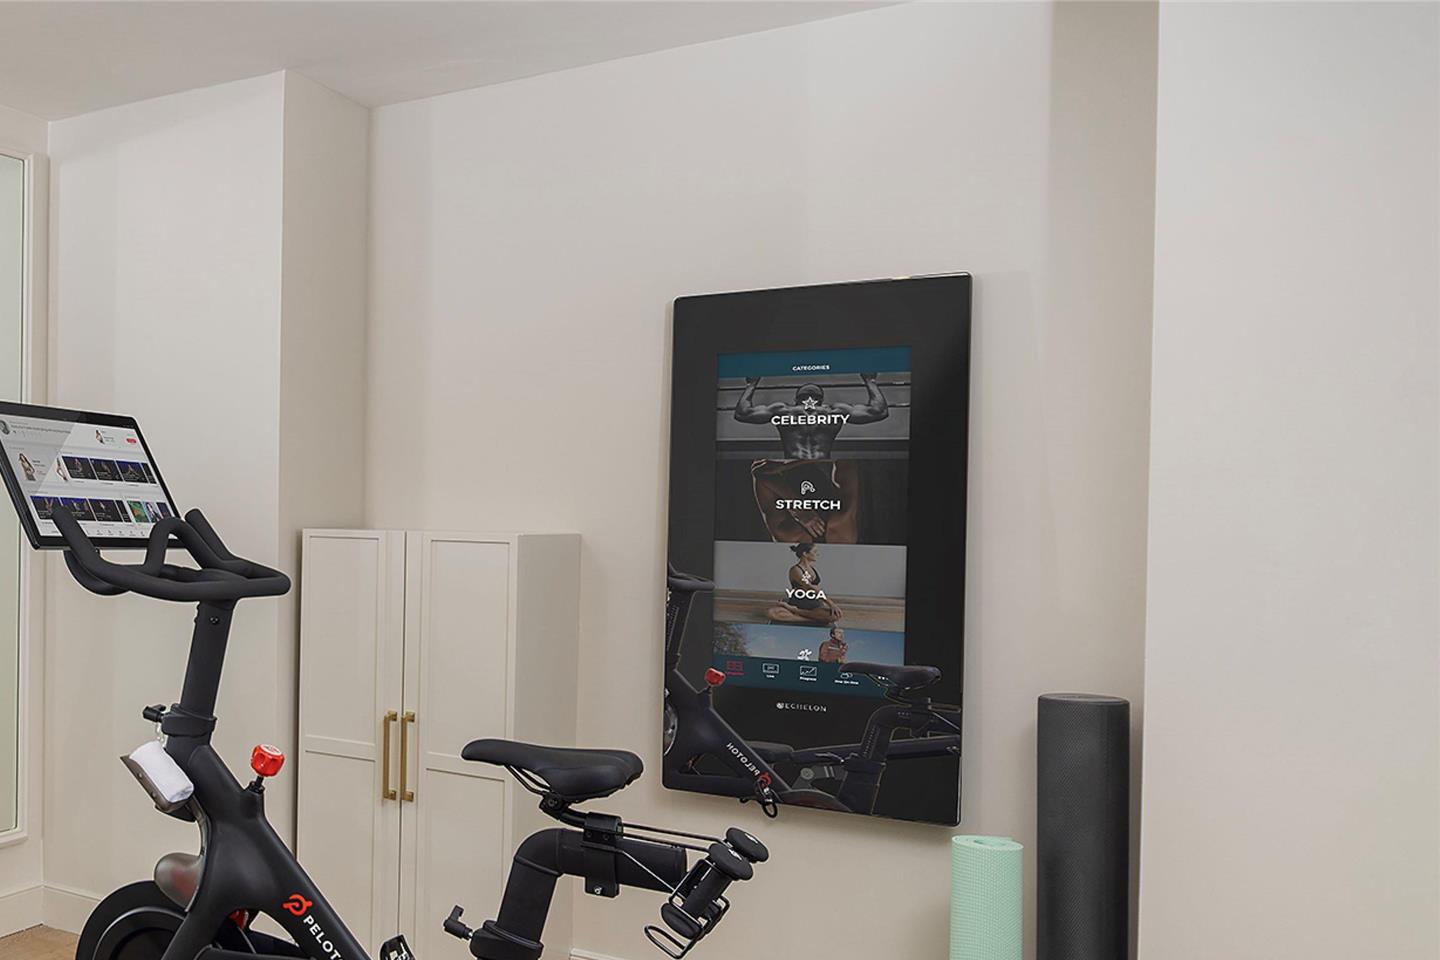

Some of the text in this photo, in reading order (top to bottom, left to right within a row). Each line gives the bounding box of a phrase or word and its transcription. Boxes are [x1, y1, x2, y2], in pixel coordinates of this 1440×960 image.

[792, 364, 831, 372] CATEGORIES
[770, 414, 850, 425] CELEBRITY
[775, 499, 841, 511] STRETCH
[785, 588, 827, 600] YOGA
[785, 703, 827, 713] ECHELON
